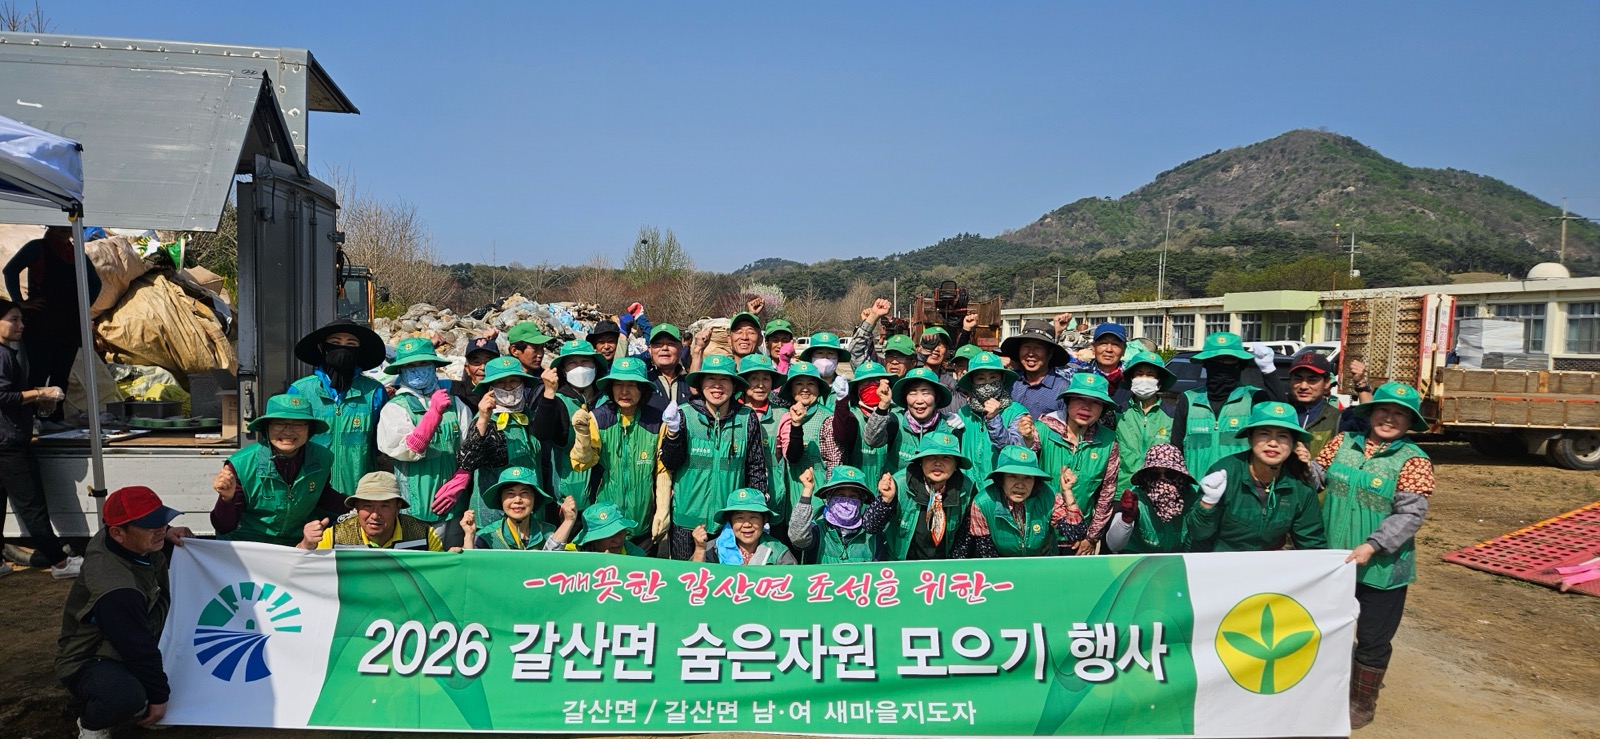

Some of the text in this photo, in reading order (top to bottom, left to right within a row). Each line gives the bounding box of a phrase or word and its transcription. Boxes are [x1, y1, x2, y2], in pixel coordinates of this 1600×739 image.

[678, 568, 794, 605] 갈산면
[806, 567, 901, 607] 조성을
[358, 618, 1167, 682] 2026 갈산면 숨은자원 모으기 행사
[562, 699, 977, 725] 갈산면 / 갈산면 남·여 새마을지도자
